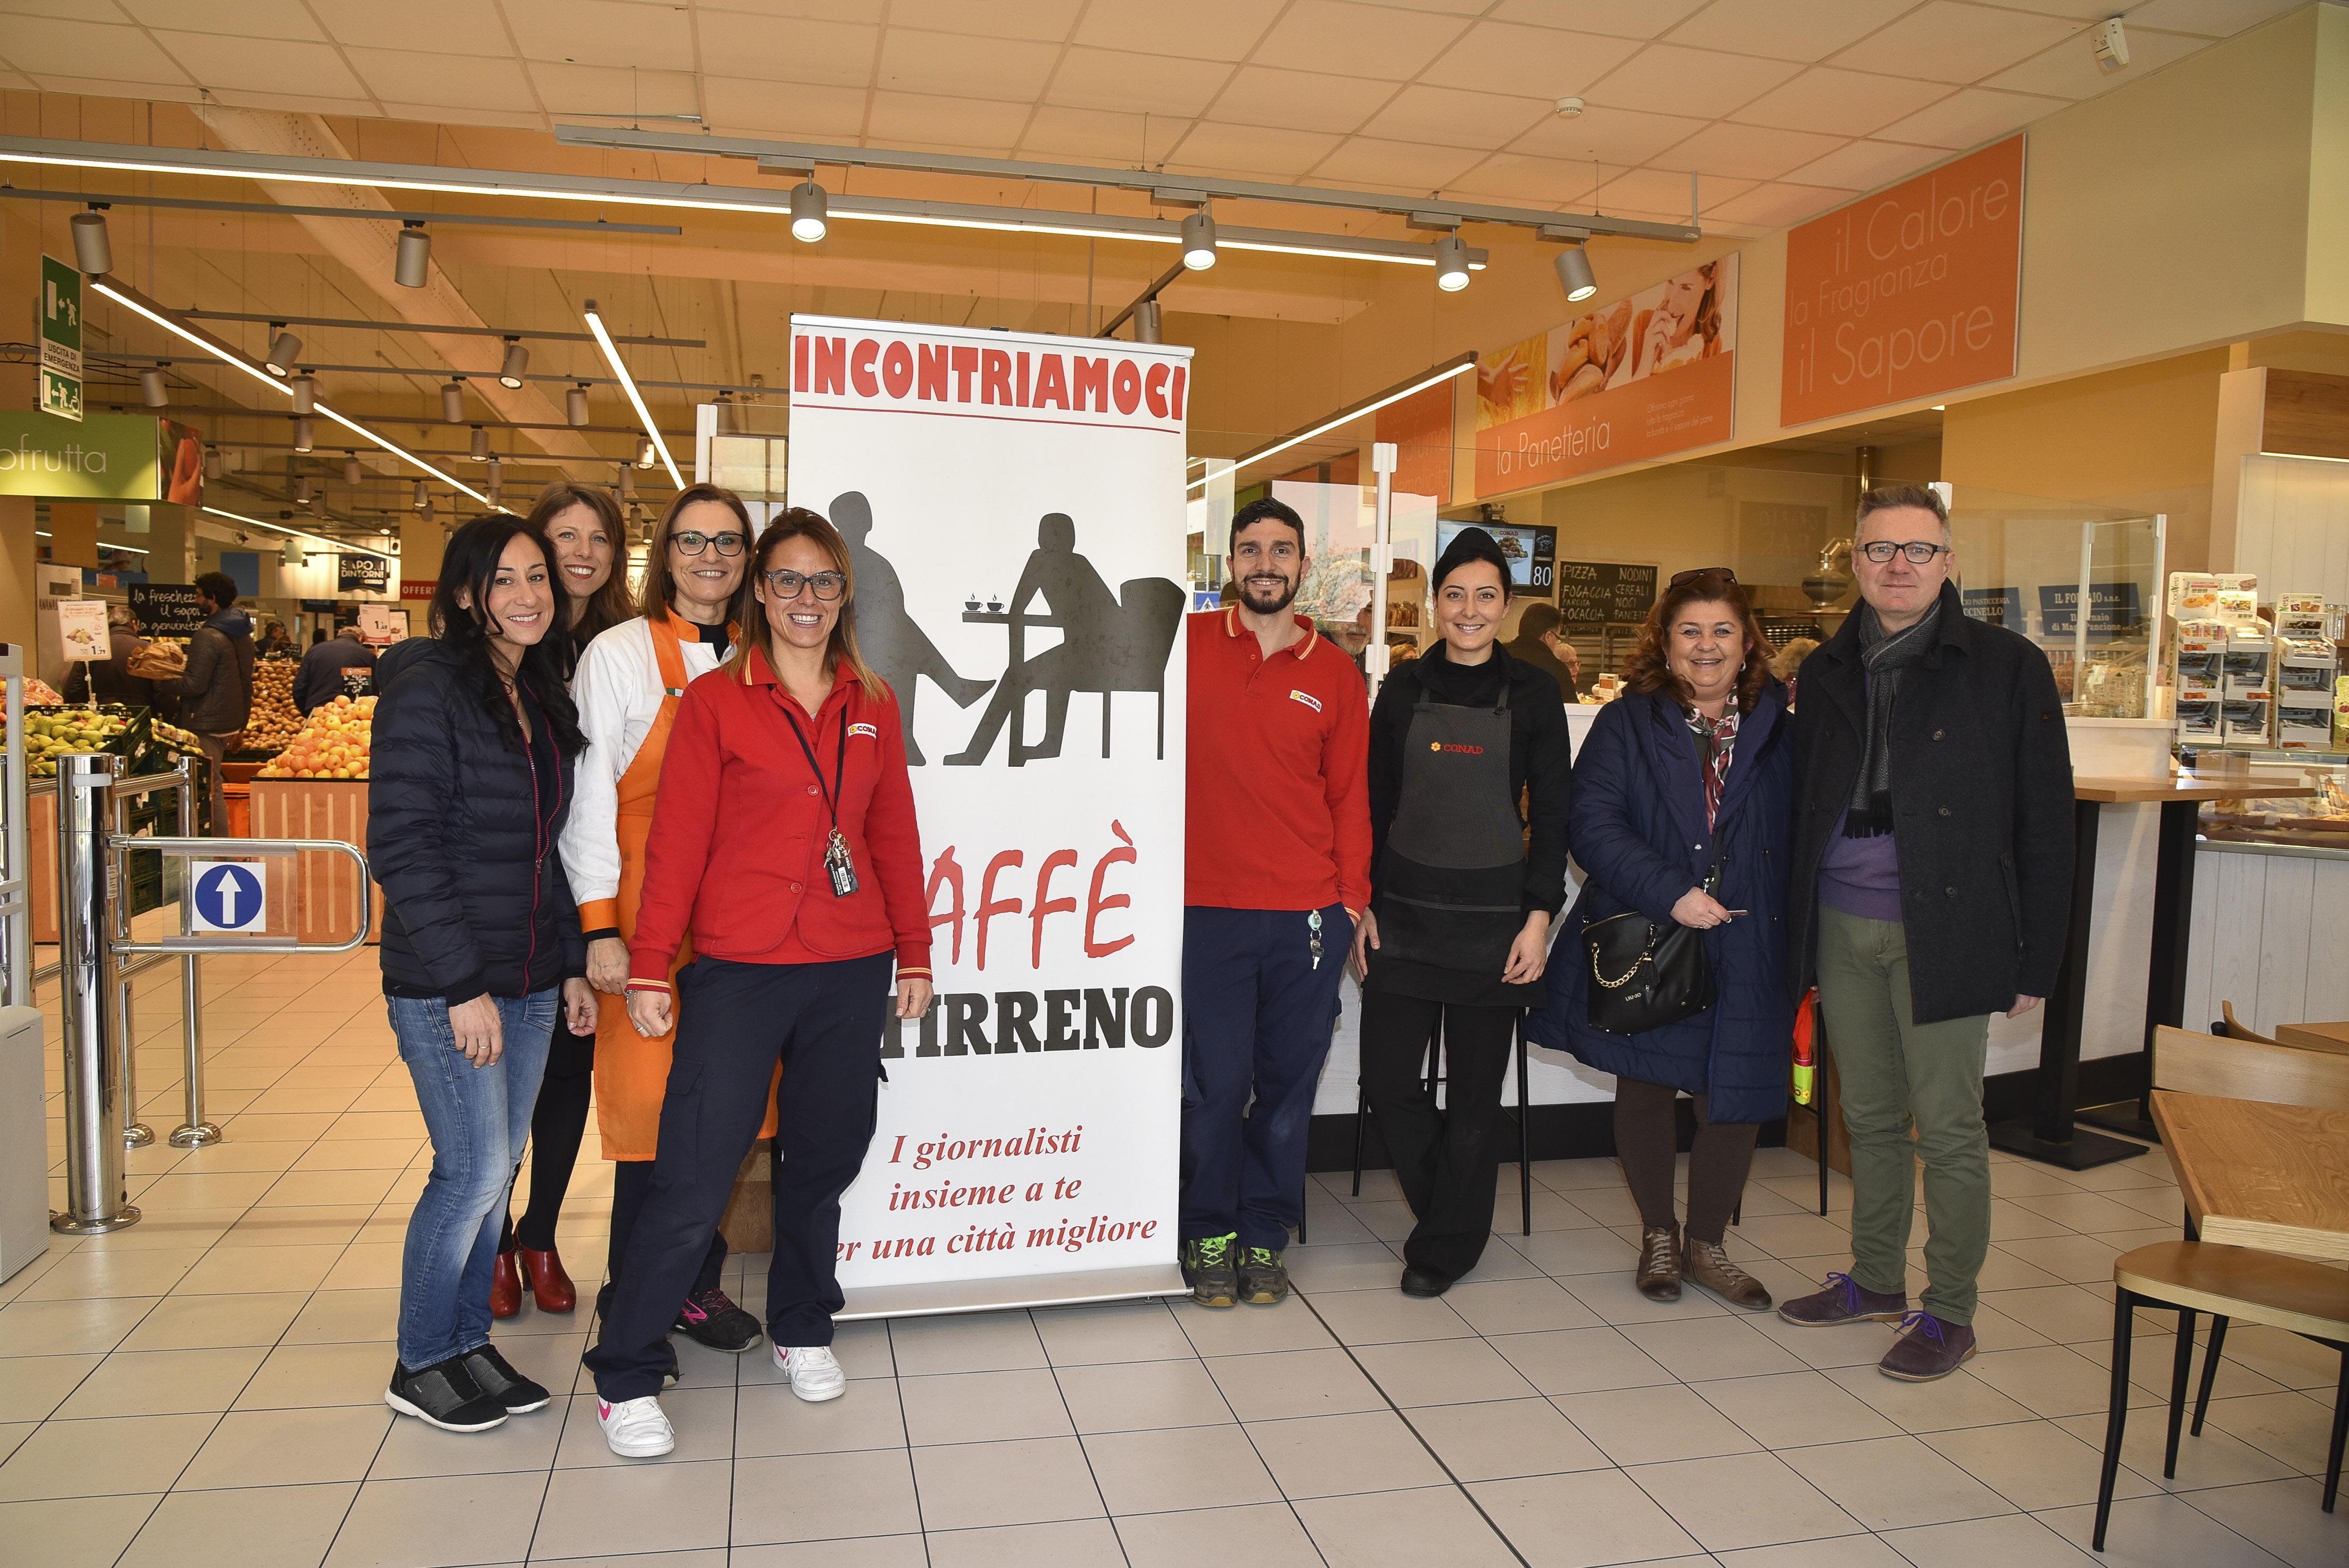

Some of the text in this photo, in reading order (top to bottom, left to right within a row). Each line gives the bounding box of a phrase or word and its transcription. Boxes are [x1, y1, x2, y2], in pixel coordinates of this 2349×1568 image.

[1835, 177, 2009, 276] il Calore
[1789, 252, 1948, 327] la Fragranza
[48, 343, 77, 361] USCITA DI
[1799, 305, 1994, 395] il Sapore
[44, 352, 80, 373] EMERGENZA
[794, 335, 1186, 421] INCONTRIAMOCI
[1496, 415, 1610, 476] la Panetteria
[341, 560, 384, 571] SPOI
[341, 570, 384, 578] DINTORNI
[1563, 565, 1597, 580] PIZZA
[1533, 566, 1551, 586] 80
[1619, 567, 1652, 583] NODINI
[133, 588, 196, 606] la freschez
[402, 586, 436, 595] OFFERT
[1615, 584, 1649, 597] CEREALI
[2055, 593, 2063, 604] IL
[2065, 592, 2103, 604] FOAIO
[1615, 597, 1636, 608] NOCI
[2279, 595, 2289, 612] Ness
[160, 604, 207, 621] il sapor
[1560, 608, 1605, 621] FOCACCIA
[1615, 609, 1648, 620] PANCETT
[2052, 622, 2060, 631] di
[1299, 695, 1321, 709] CONAD
[1443, 744, 1484, 755] CONAD
[924, 819, 1137, 970] AFFÈ
[887, 1124, 1083, 1171] I giornalisti
[888, 1174, 1083, 1211] insieme a te
[835, 1214, 1158, 1263] er una città migliore
